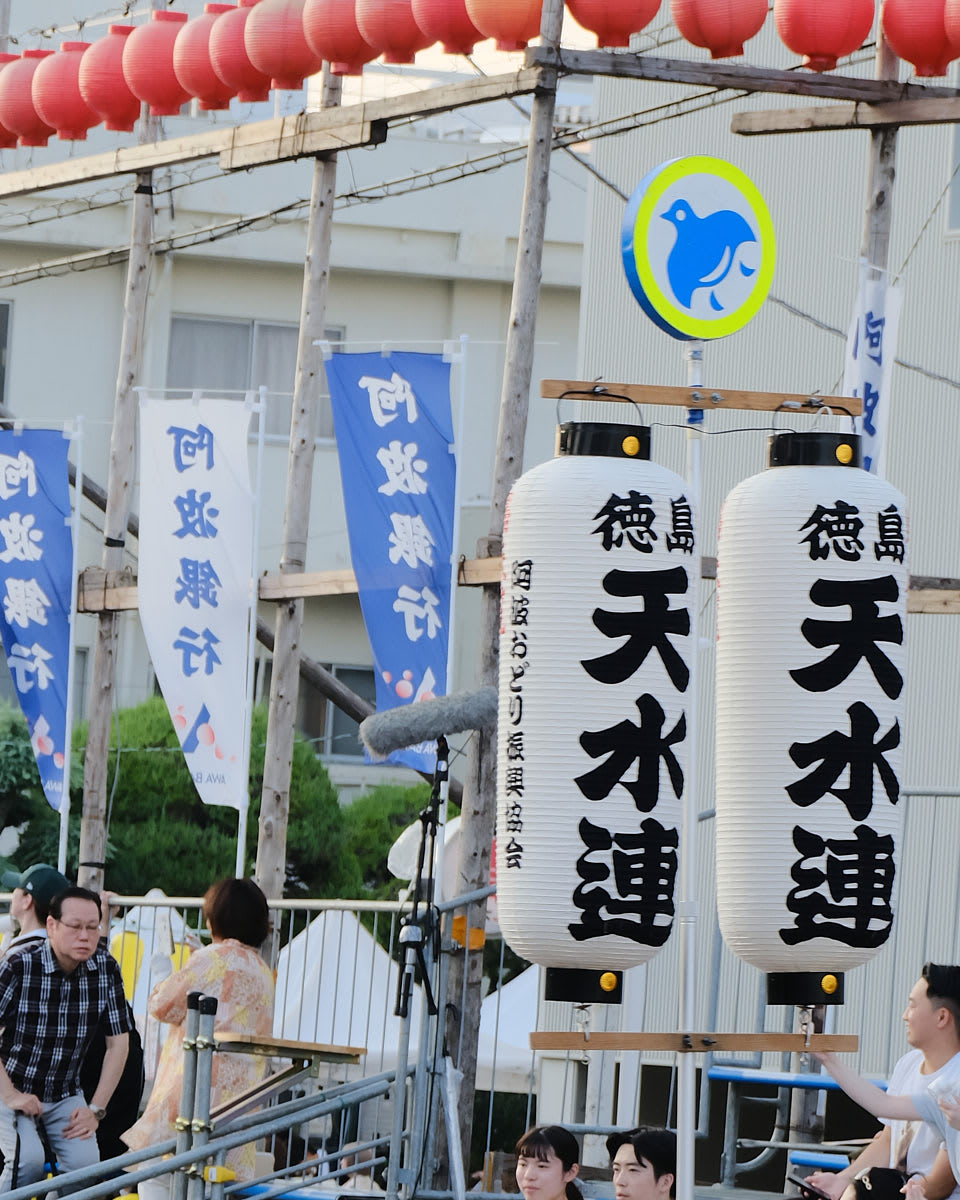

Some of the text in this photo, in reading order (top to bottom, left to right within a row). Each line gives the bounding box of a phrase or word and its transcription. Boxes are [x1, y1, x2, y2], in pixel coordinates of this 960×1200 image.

[591, 490, 695, 555] 徳島
[798, 500, 906, 564] 徳島
[568, 566, 691, 948] 天水連
[779, 574, 904, 949] 天水連
